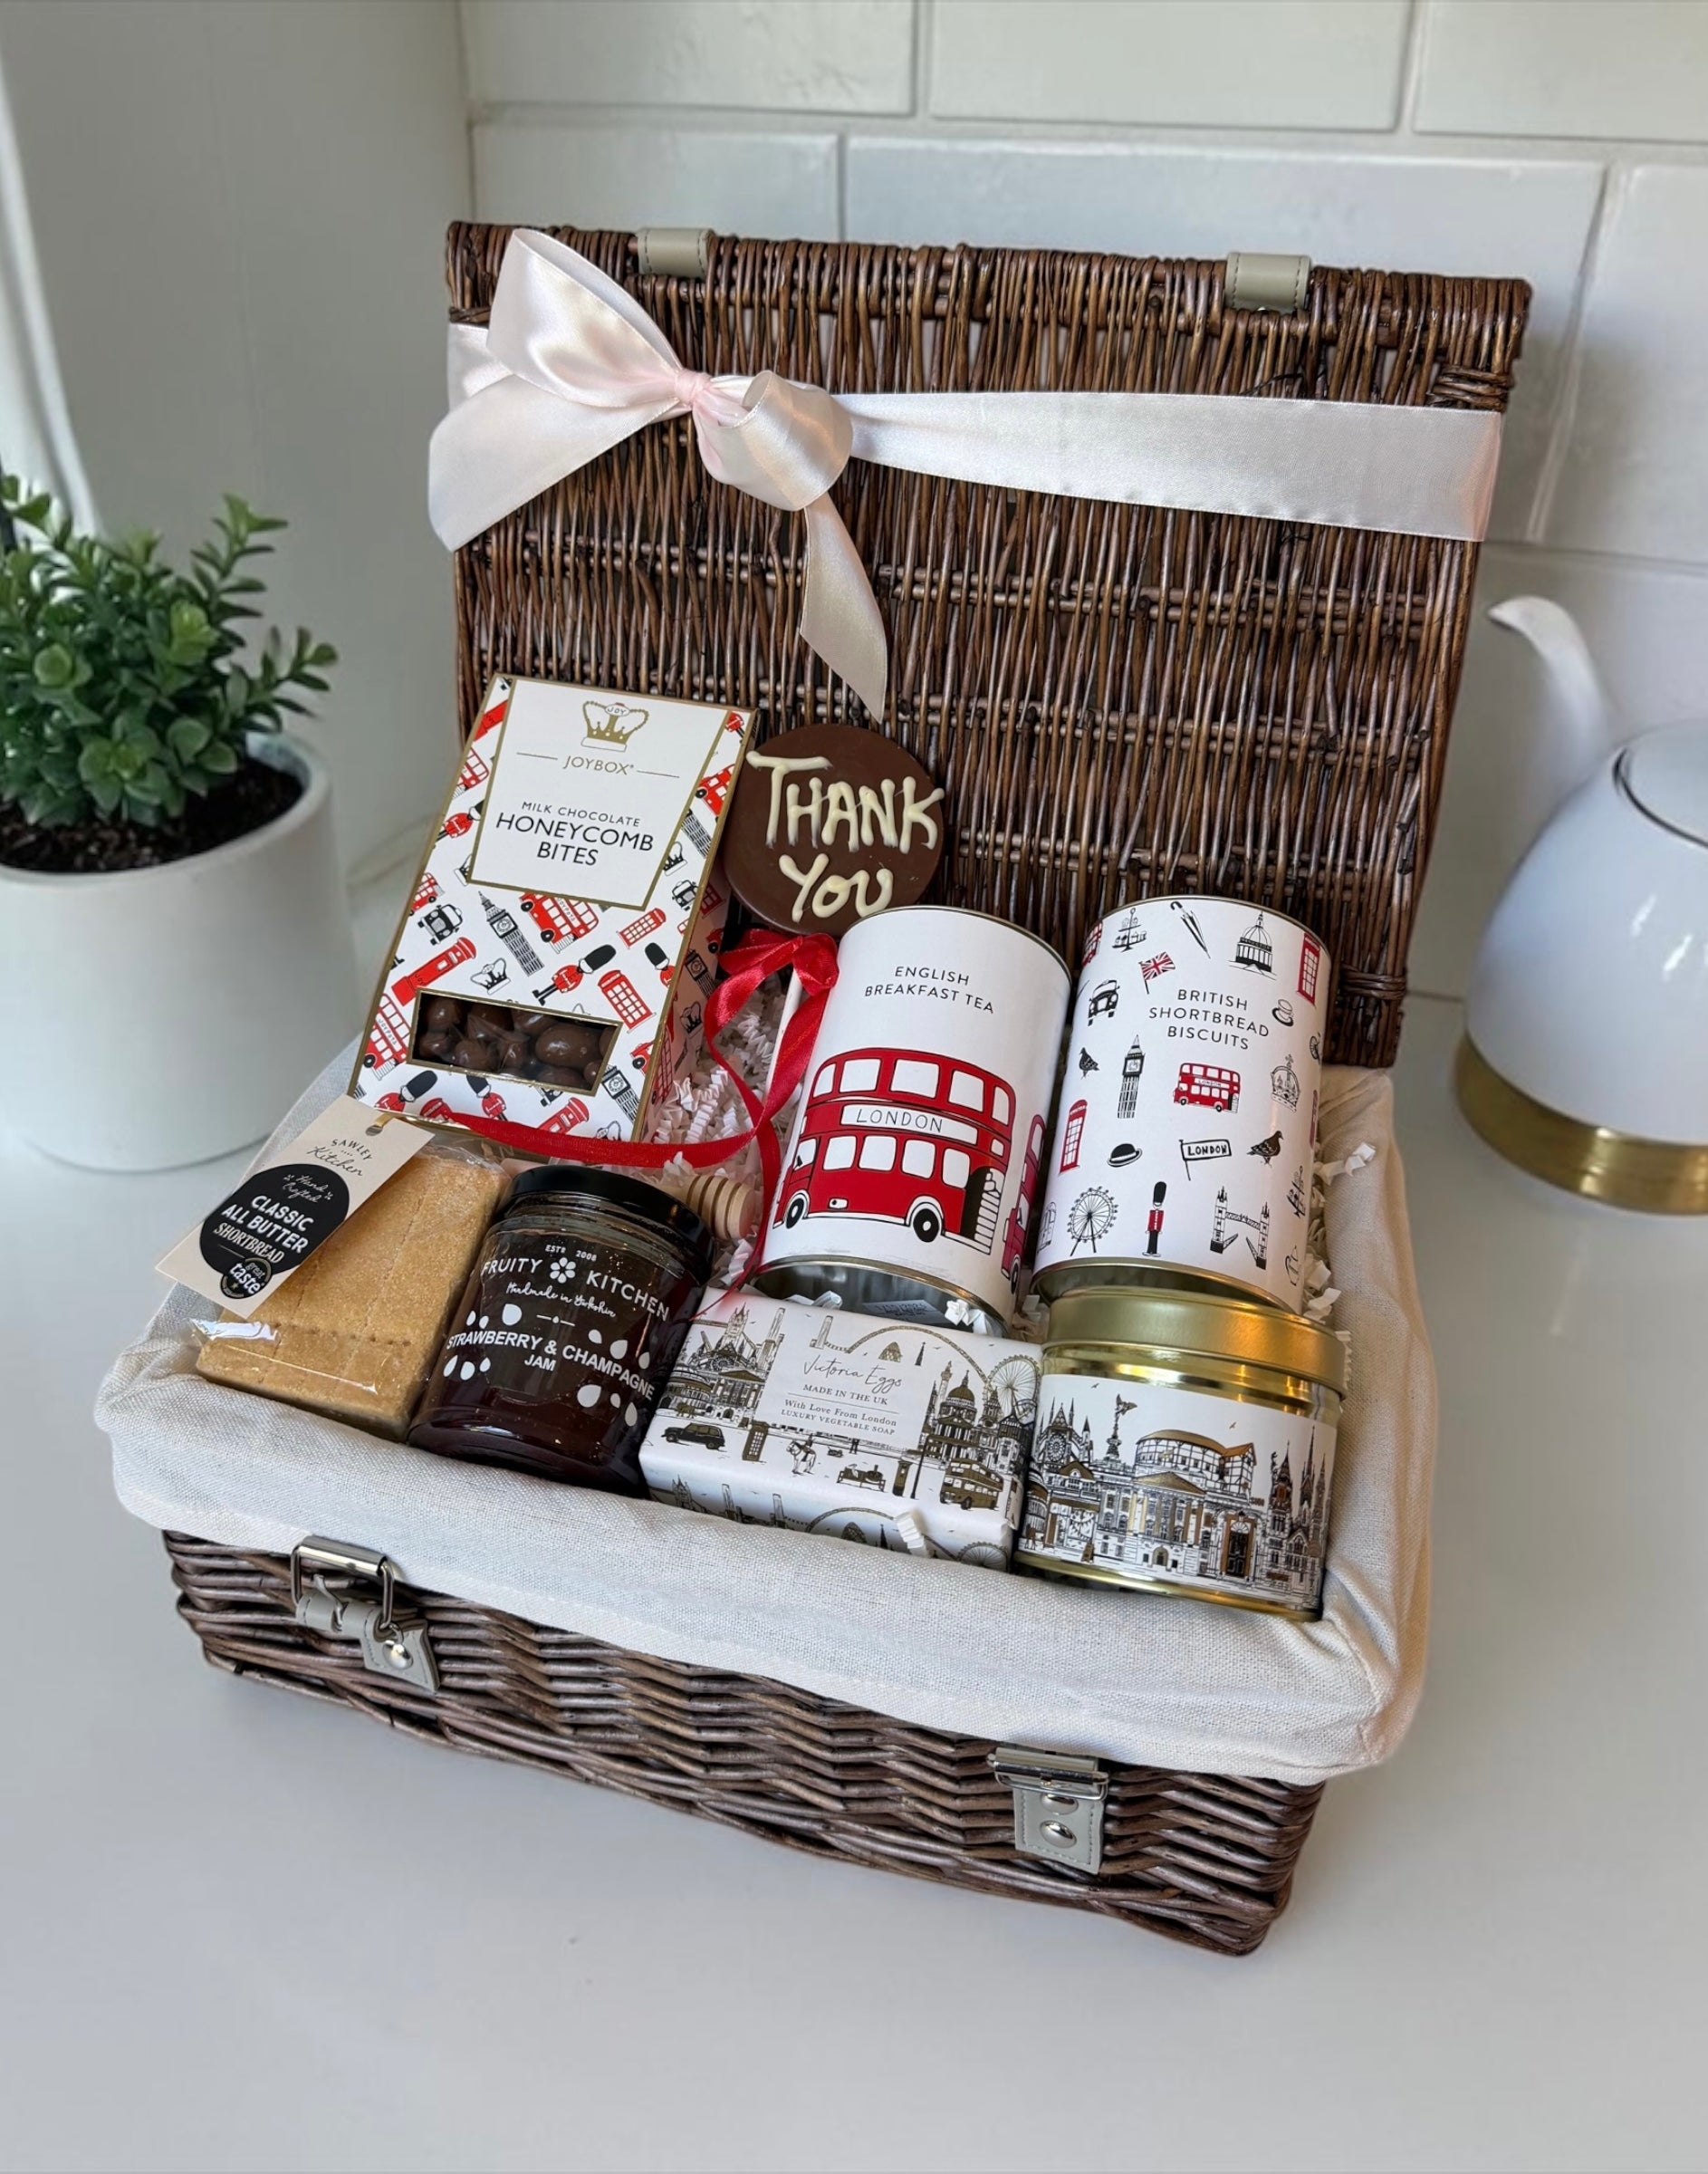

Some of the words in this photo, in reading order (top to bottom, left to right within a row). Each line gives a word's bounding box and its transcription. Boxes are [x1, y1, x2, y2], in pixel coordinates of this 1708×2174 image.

[607, 707, 627, 715] JOY
[522, 802, 552, 813] MILK
[558, 806, 641, 827] CHOCOLATE
[745, 750, 945, 854] THANK
[496, 813, 654, 851] HONEYCOMB
[537, 842, 599, 866] BITES
[779, 852, 894, 923] YOU
[895, 966, 969, 986] ENGLISH
[865, 984, 960, 1001] BREAKFAST
[965, 994, 994, 1014] TEA
[1177, 989, 1248, 1011] BRITISH
[1148, 1007, 1269, 1037] SHORTBREAD
[1167, 1025, 1249, 1050] BISCUITS
[1198, 1080, 1222, 1088] LONDON
[856, 1108, 943, 1133] LONDON
[307, 1146, 362, 1177] Kitchen
[331, 1139, 372, 1160] SAWLEY
[1187, 1144, 1227, 1156] LONDON
[283, 1182, 322, 1203] Crafted
[296, 1175, 329, 1192] Hand
[252, 1196, 314, 1232] CLASSIC
[221, 1204, 250, 1224] ALL
[247, 1215, 309, 1254] BUTTER
[213, 1222, 285, 1264] SHORTBREAD
[230, 1263, 262, 1294] taste
[245, 1262, 266, 1279] great
[481, 1258, 543, 1276] FRUITY
[586, 1270, 670, 1322] KITCHEN
[505, 1282, 559, 1300] Handmade
[561, 1293, 572, 1303] in
[573, 1295, 617, 1318] Yorkshire
[446, 1330, 543, 1351] STRAWBERRY
[544, 1340, 558, 1356] &
[561, 1344, 656, 1401] CHAMPAGNE
[524, 1353, 557, 1372] JAM
[803, 1354, 864, 1379] Victoria
[864, 1364, 903, 1394] Eggs
[802, 1384, 833, 1396] MADE
[835, 1390, 848, 1398] IN
[849, 1392, 870, 1402] THE
[873, 1397, 888, 1406] UK
[781, 1409, 817, 1420] LUXURY
[820, 1416, 870, 1431] VEGETABLE
[872, 1426, 896, 1436] SOAP
[784, 1399, 806, 1409] With
[809, 1404, 831, 1414] Love
[834, 1408, 859, 1419] From
[861, 1413, 897, 1427] London
